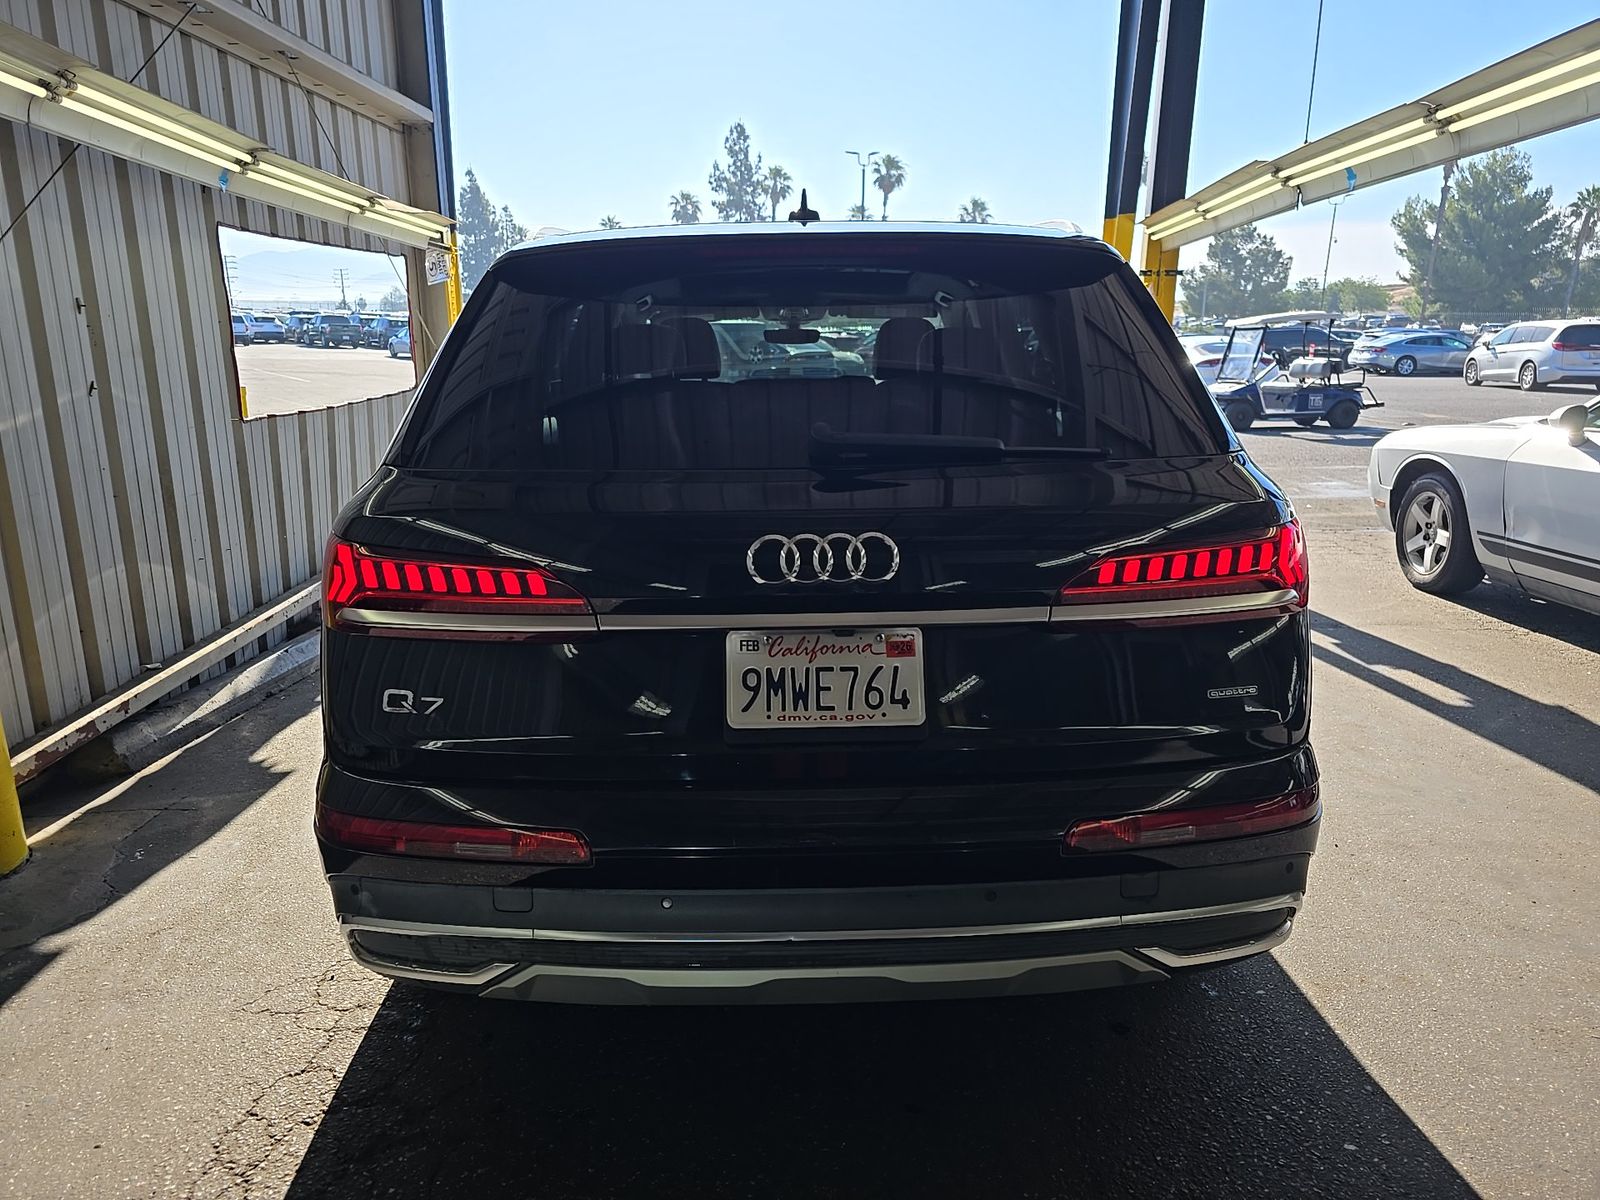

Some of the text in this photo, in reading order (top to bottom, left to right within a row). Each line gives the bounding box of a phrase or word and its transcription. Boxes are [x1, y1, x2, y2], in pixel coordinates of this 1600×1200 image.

[739, 639, 760, 652] FEB
[767, 635, 888, 664] California
[741, 665, 911, 713] 9MWE764
[1210, 687, 1257, 697] quattro
[382, 688, 444, 715] Q7
[776, 713, 877, 723] dmv.ca.gov
